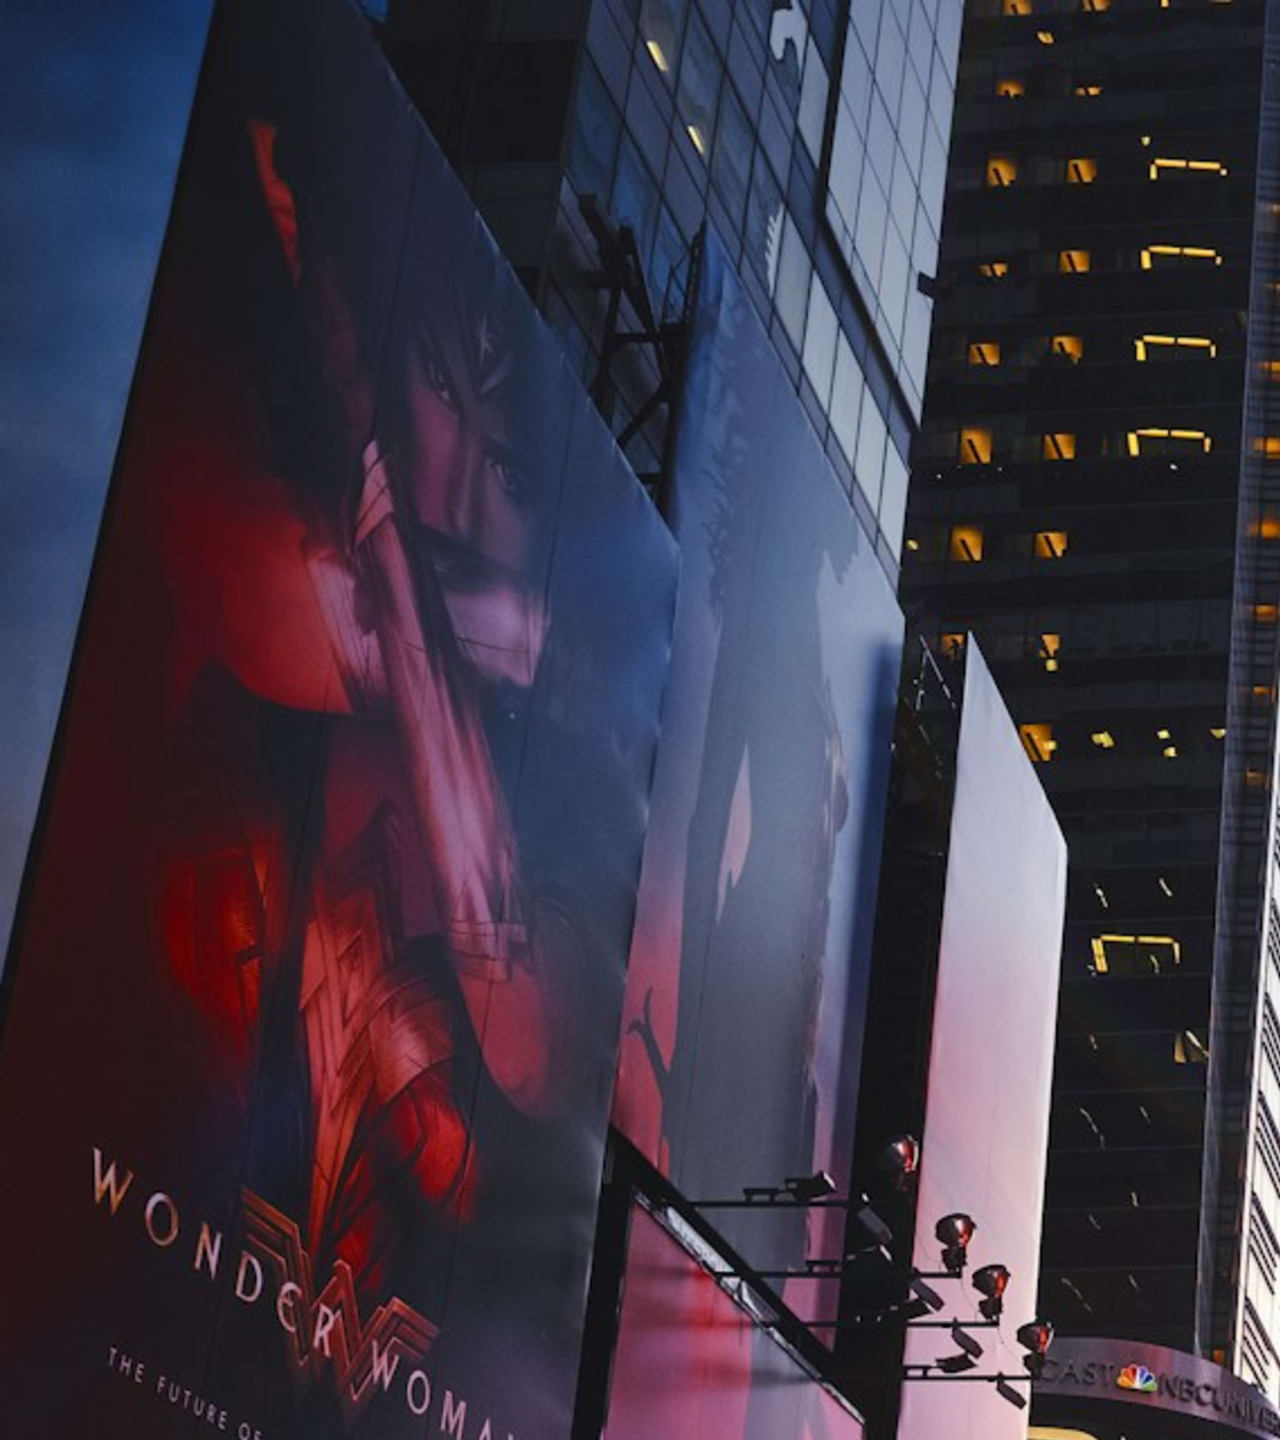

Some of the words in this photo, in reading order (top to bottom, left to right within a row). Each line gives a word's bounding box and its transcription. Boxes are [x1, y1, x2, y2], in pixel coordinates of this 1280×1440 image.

[91, 1147, 342, 1358] WONDER
[109, 1347, 144, 1384] THE
[156, 1376, 227, 1431] FUTURE
[1041, 1357, 1114, 1386] CAST
